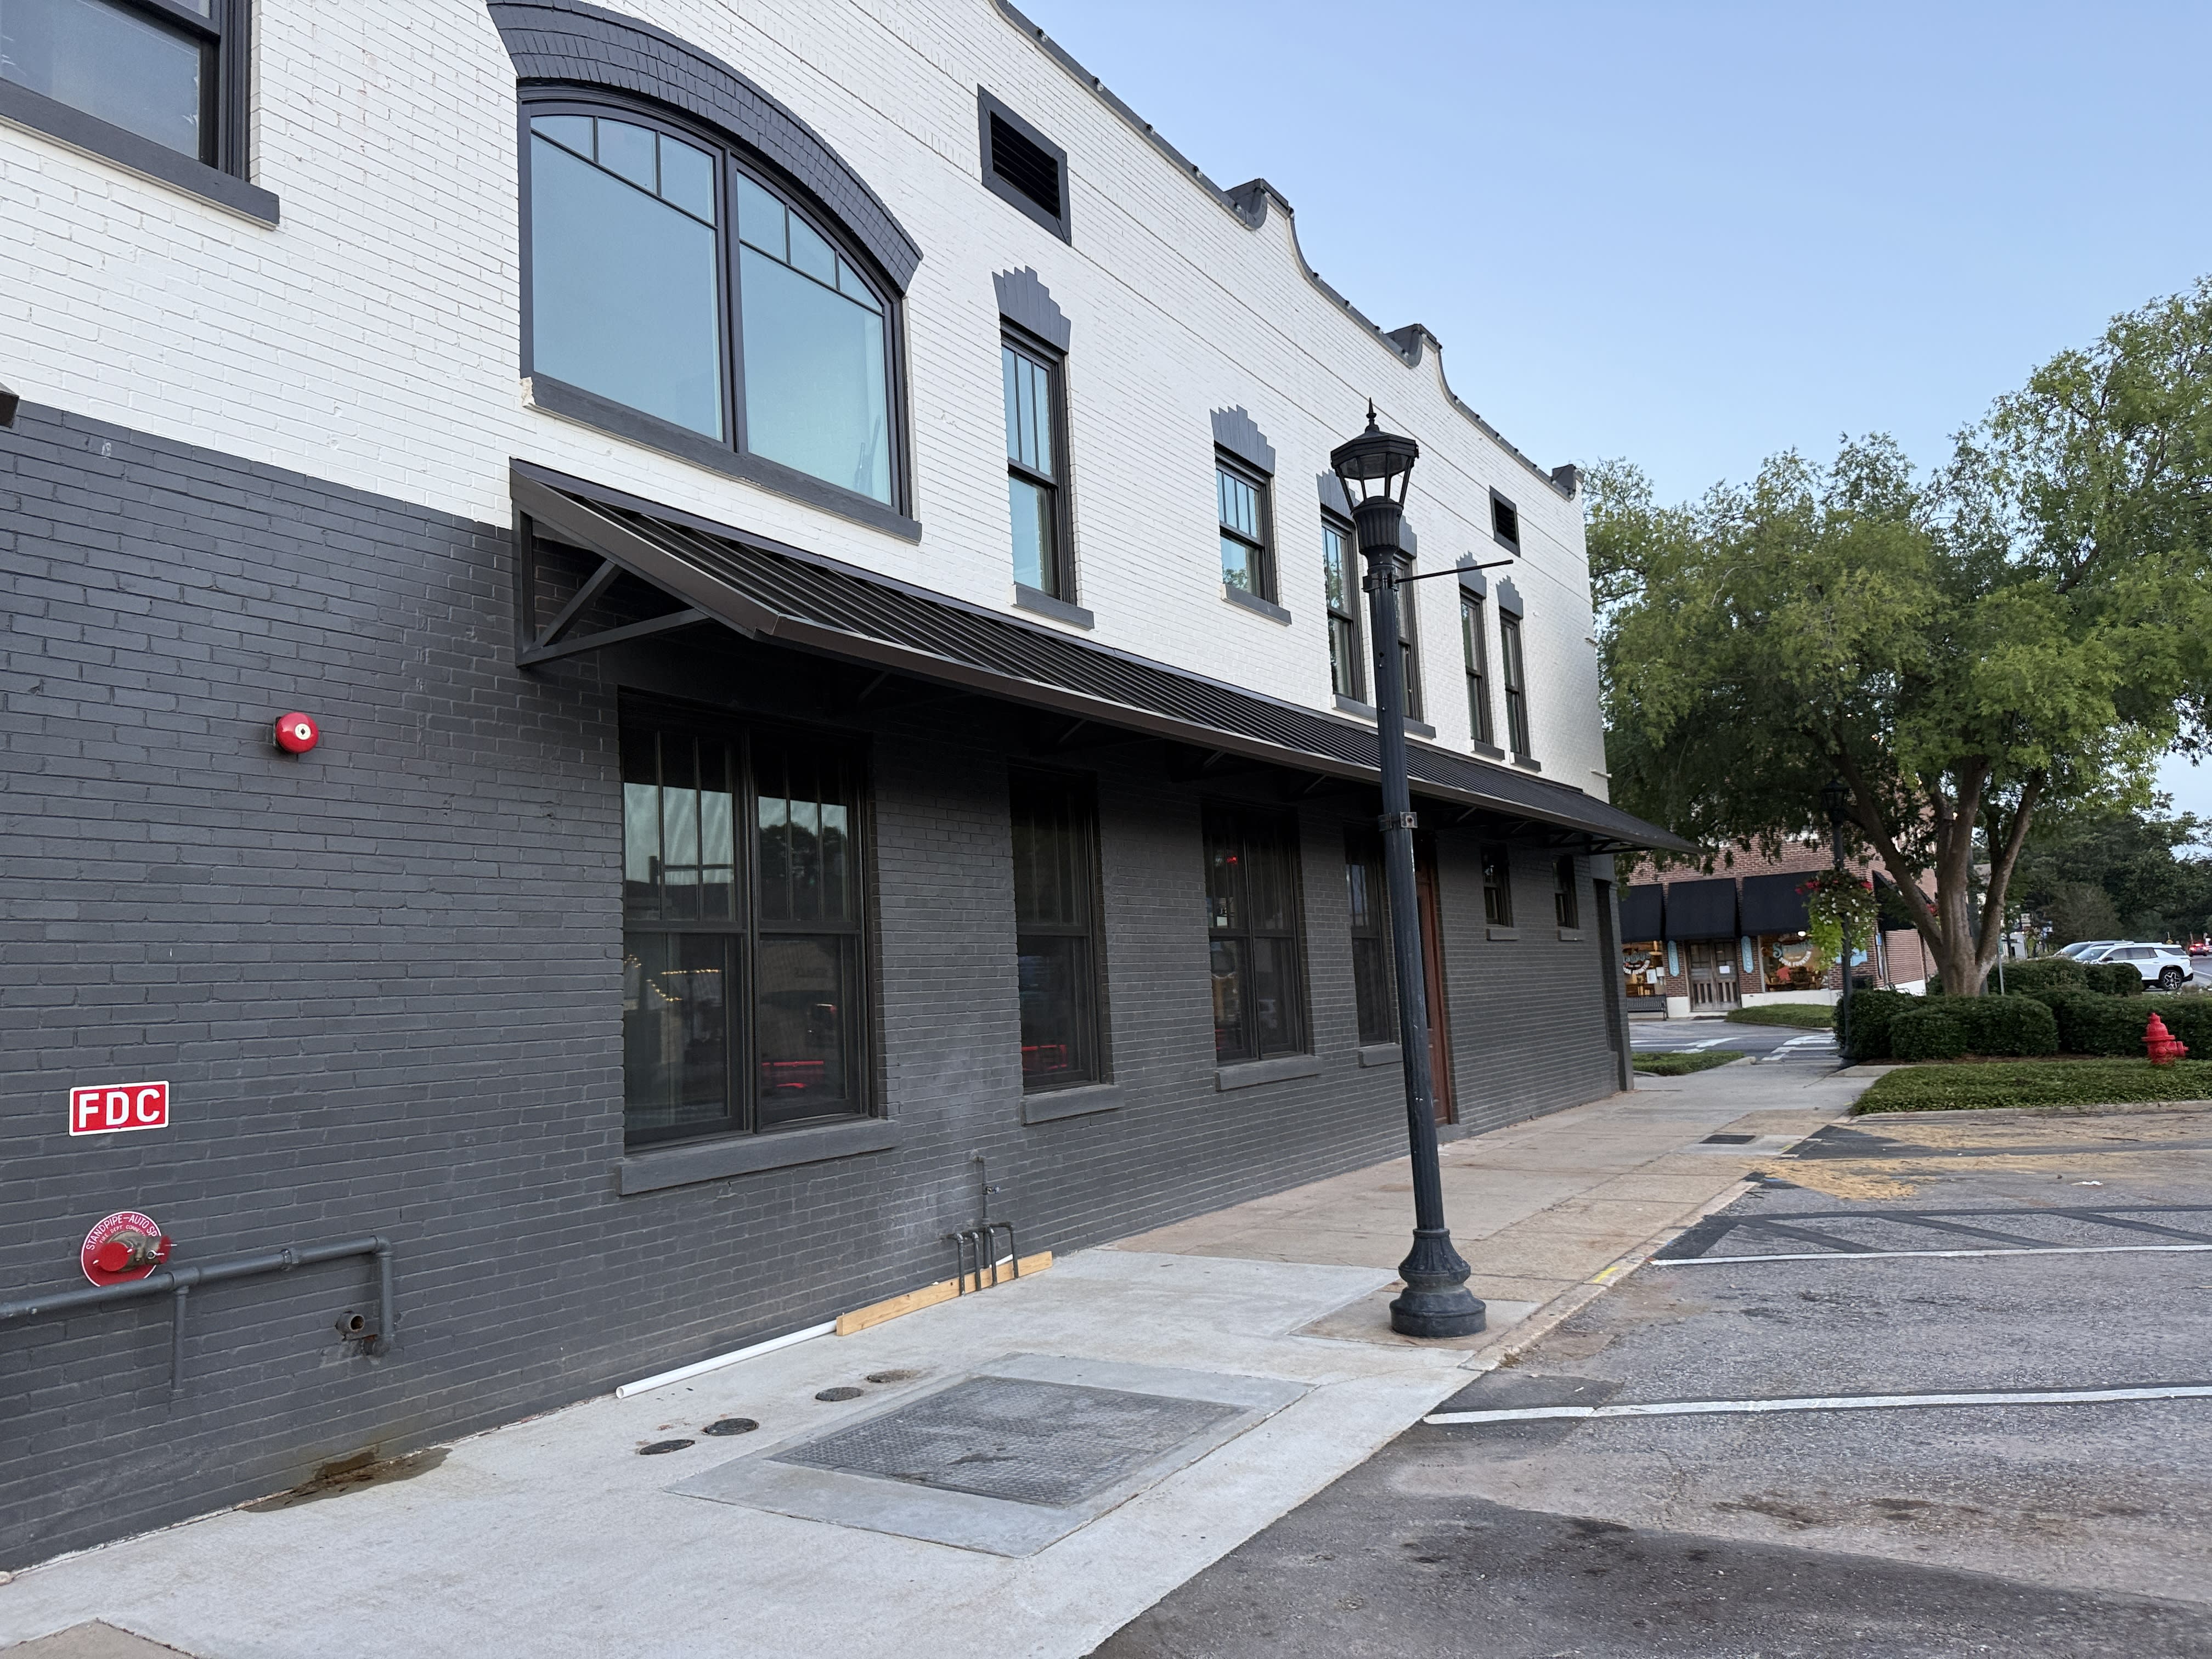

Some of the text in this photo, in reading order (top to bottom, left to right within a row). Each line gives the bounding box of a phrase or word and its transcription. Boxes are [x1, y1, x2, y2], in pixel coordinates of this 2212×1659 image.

[78, 1088, 160, 1128] FDC
[99, 1233, 109, 1244] FIRE
[110, 1225, 123, 1233] DEPT
[146, 1226, 157, 1237] SP
